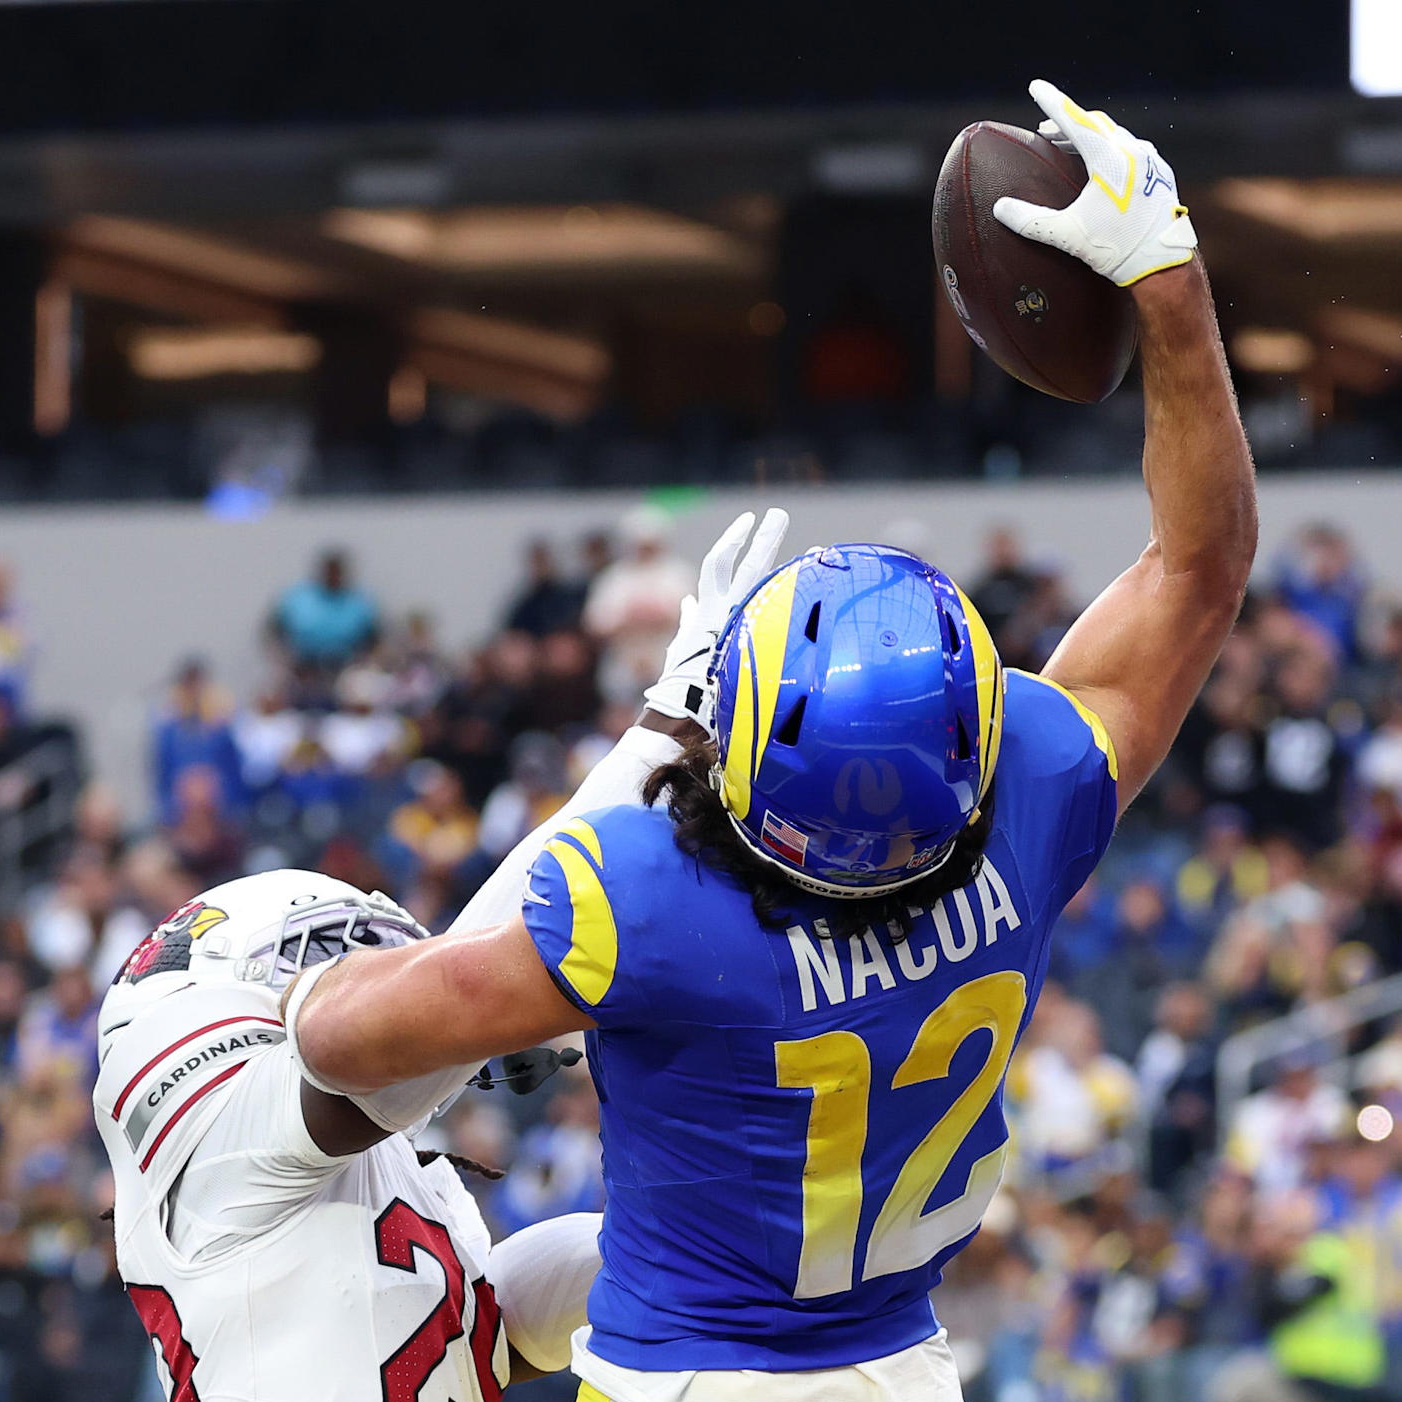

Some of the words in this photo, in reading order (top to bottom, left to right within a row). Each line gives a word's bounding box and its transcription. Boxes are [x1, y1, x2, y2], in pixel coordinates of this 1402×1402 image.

[785, 854, 1022, 1012] NACUA
[147, 1033, 273, 1107] CARDINALS
[773, 970, 1027, 1300] 12
